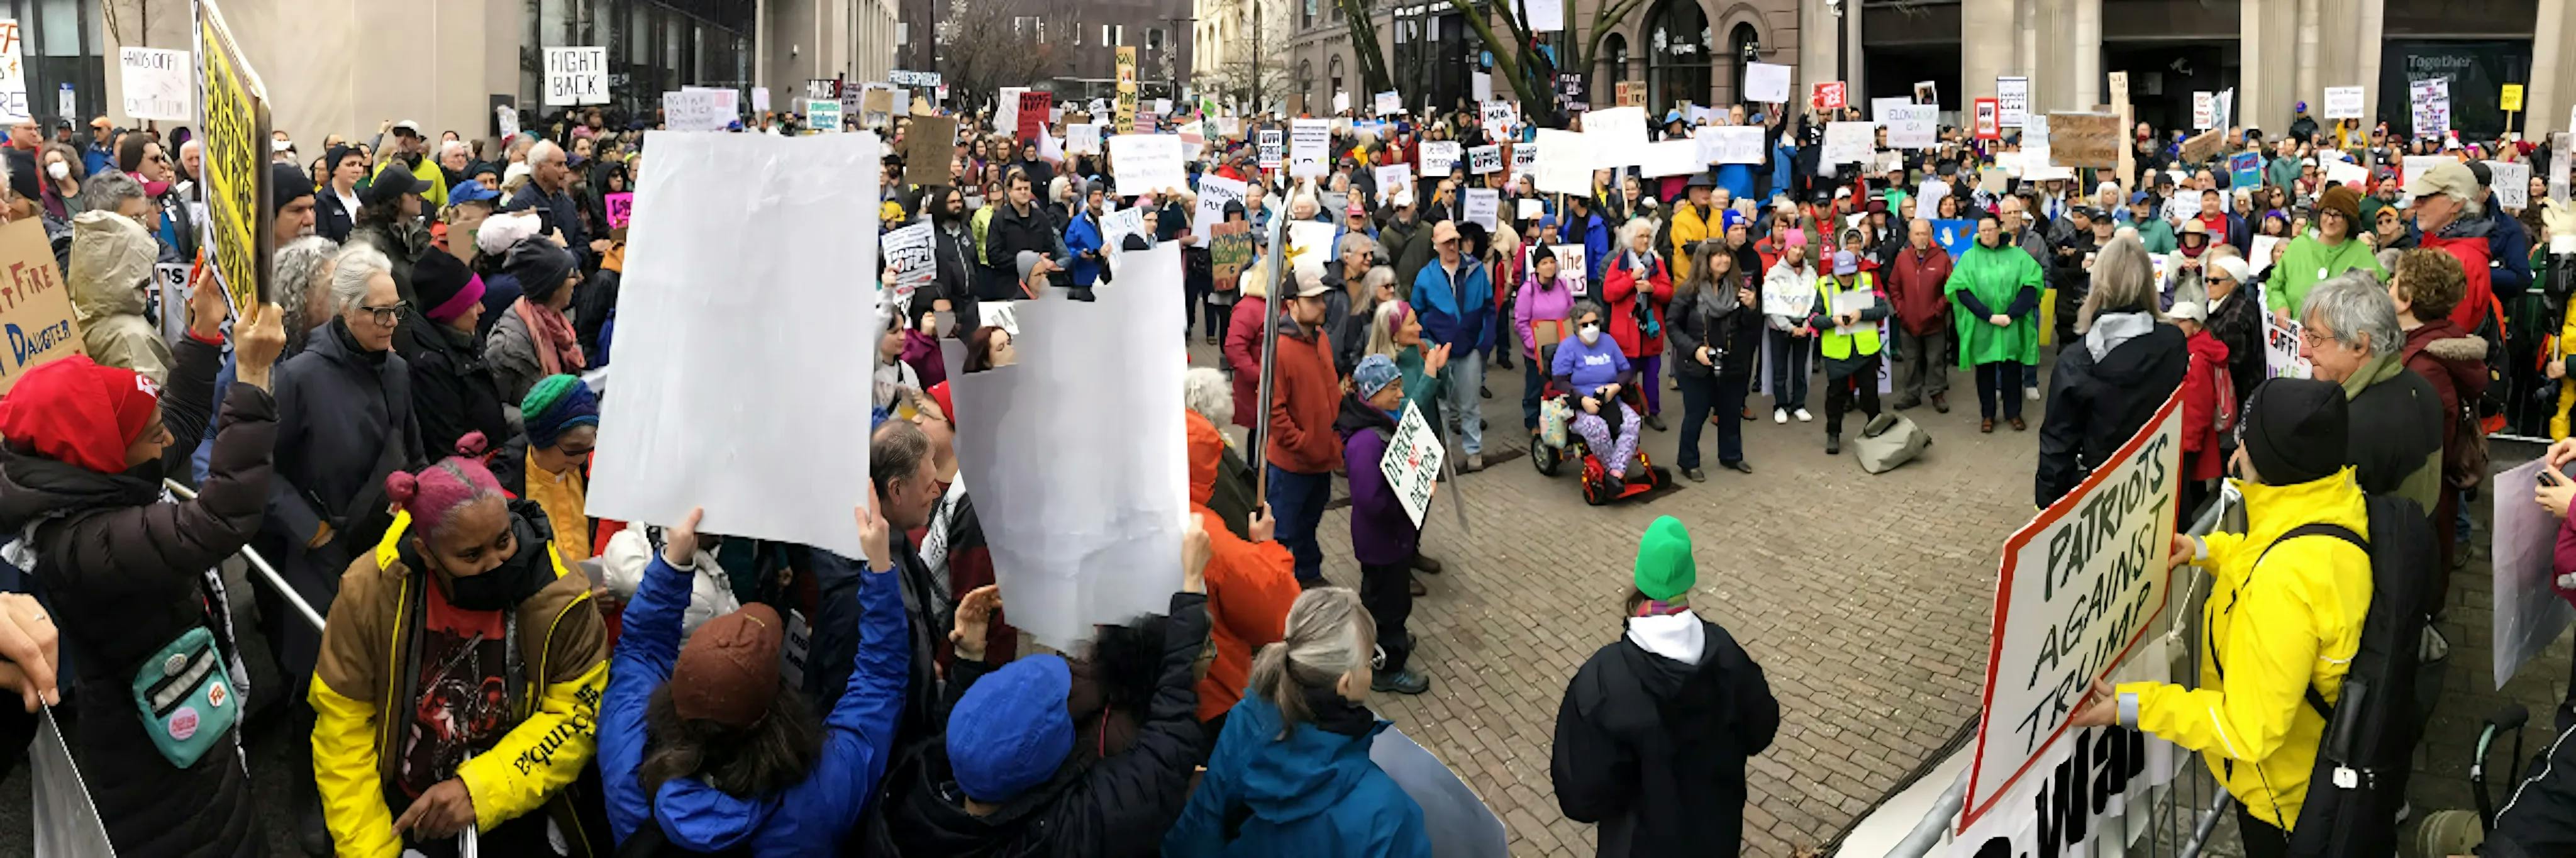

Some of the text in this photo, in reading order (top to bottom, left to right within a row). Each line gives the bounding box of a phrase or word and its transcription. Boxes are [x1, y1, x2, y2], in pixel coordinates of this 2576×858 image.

[551, 51, 601, 73] FIGHT
[2407, 55, 2472, 70] Together
[553, 74, 597, 97] BACK
[1889, 108, 1911, 120] ELON
[9, 260, 54, 303] FIRE
[2044, 433, 2168, 603] PATRIOTS
[2027, 493, 2168, 691] AGAINST
[2014, 581, 2151, 755] TRUMP
